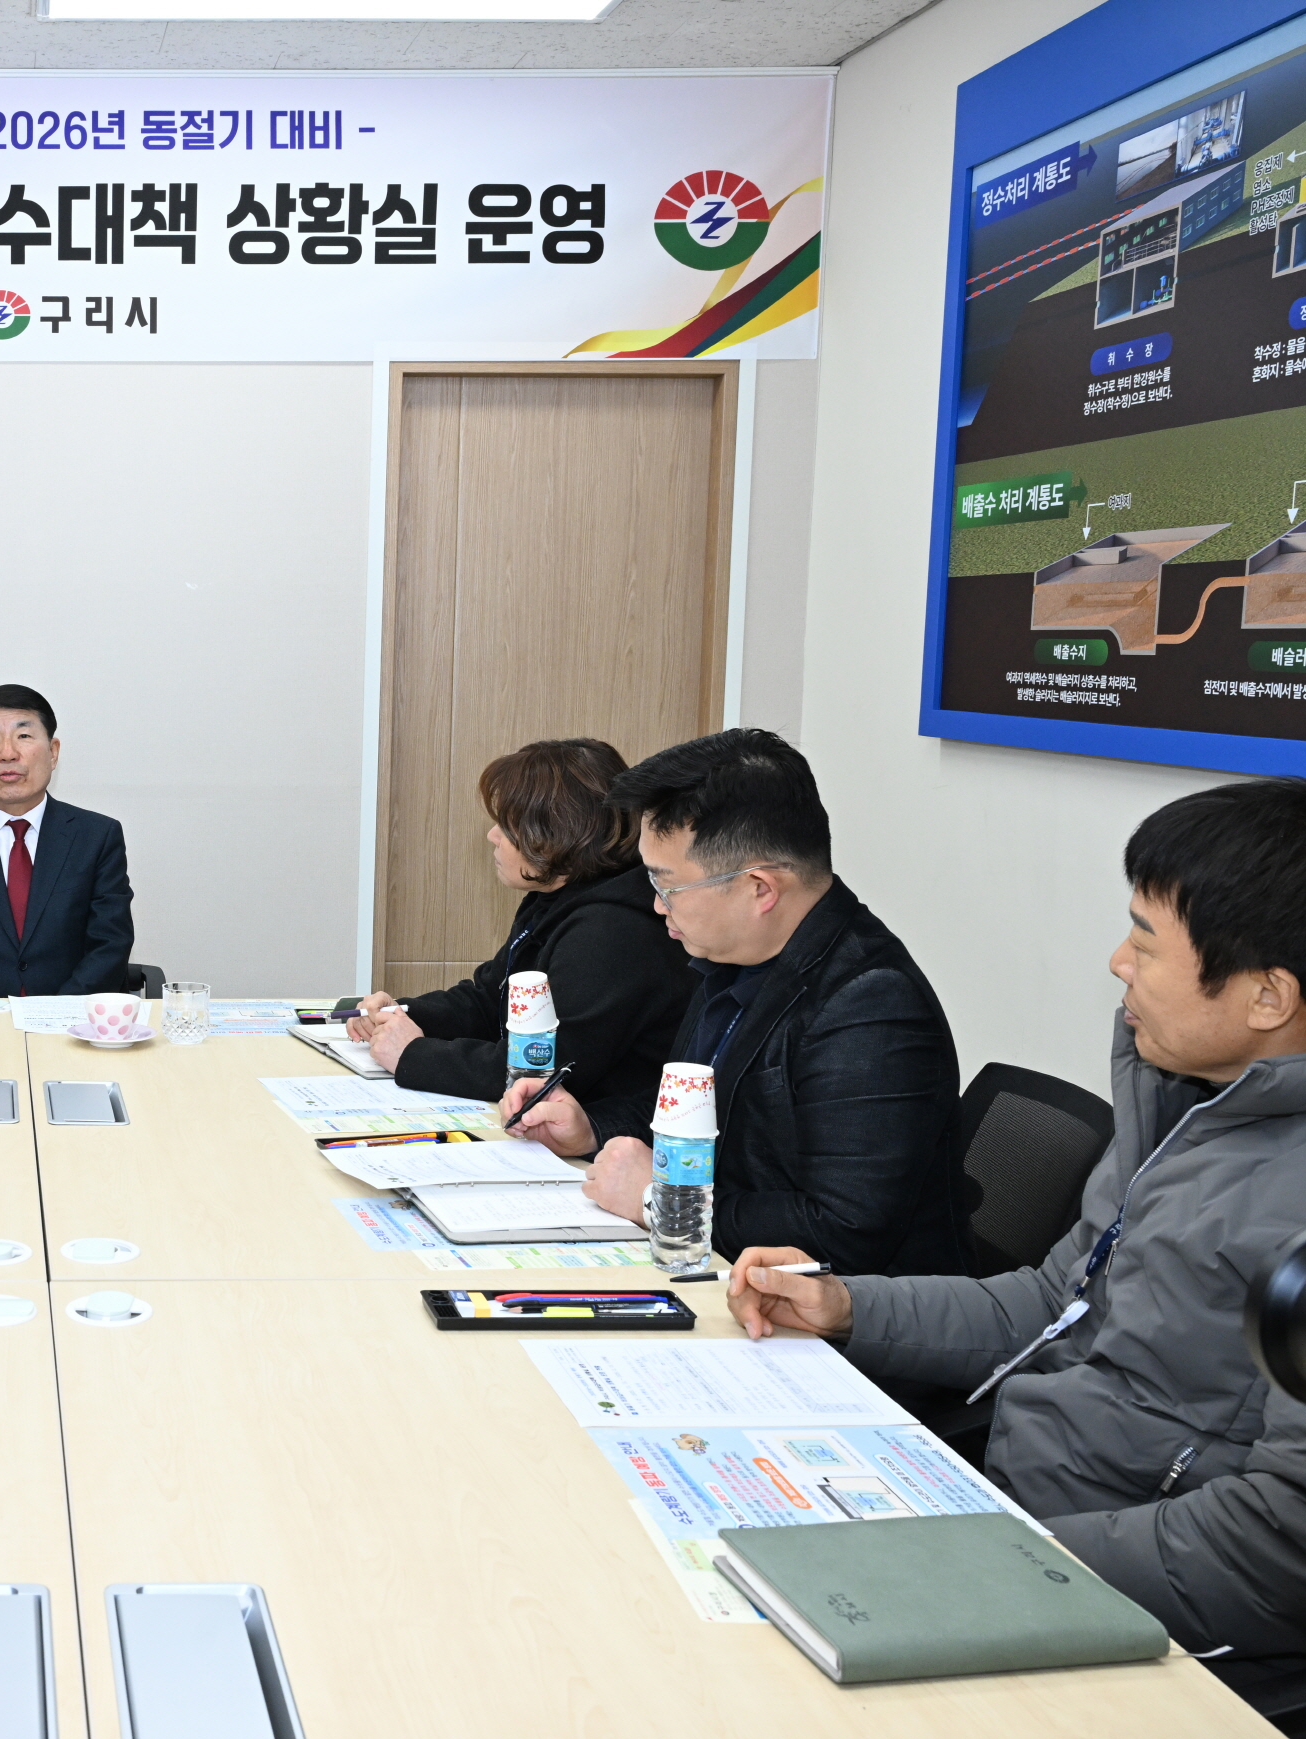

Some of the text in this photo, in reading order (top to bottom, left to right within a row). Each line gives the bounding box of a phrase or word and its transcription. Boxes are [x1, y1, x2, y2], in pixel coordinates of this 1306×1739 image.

[140, 109, 253, 151] 동절기
[269, 109, 343, 151] 대비
[1254, 152, 1284, 177] 응집제
[981, 156, 1072, 217] 정수처리 계통도
[1253, 177, 1272, 197] 염소
[1250, 185, 1295, 216] PH조정제
[226, 182, 438, 265] 상황실
[465, 182, 606, 265] 운영
[1249, 210, 1278, 236] 활성탄
[39, 295, 158, 335] 구리시
[1254, 336, 1306, 362] 착수정 물을
[1087, 366, 1171, 397] 취수구로 부터 한강원수를
[1252, 362, 1280, 383] 혼화지
[1083, 384, 1173, 416] 정수장(착수정)으로 보낸다.
[961, 483, 1064, 519] 배출수 처리 계통도
[1107, 493, 1132, 510] 여과지
[1053, 644, 1087, 660] 배출수지
[1006, 671, 1024, 684] 여과지
[1048, 673, 1055, 686] 및
[1055, 673, 1081, 688] 배슬러지
[1203, 679, 1229, 696] 침전지
[1229, 680, 1238, 696] 및
[1238, 681, 1292, 699] 배출수지에서
[1017, 687, 1035, 701] 발생한
[1035, 688, 1060, 703] 슬러지는
[1098, 692, 1121, 708] 보낸다.
[528, 1048, 551, 1058] 백산수
